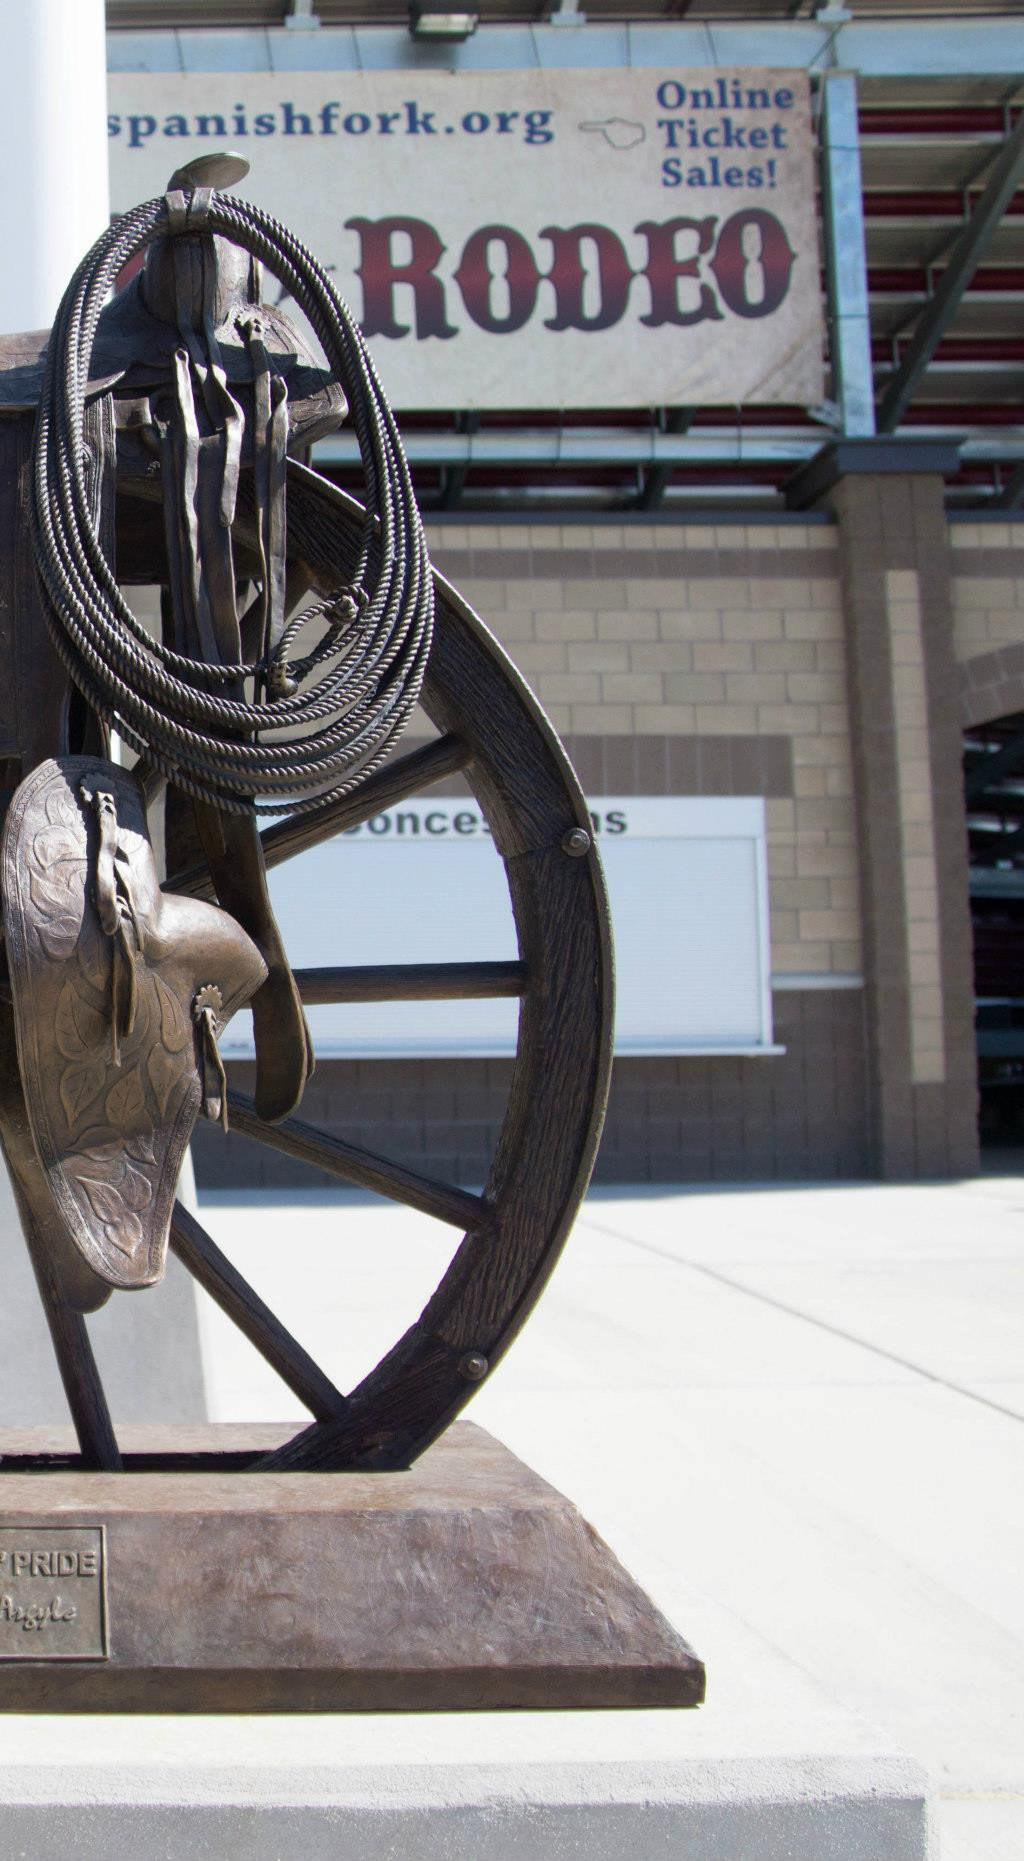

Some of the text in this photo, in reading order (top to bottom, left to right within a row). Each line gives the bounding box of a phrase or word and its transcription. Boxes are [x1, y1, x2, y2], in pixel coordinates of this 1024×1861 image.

[656, 78, 795, 110] Online
[657, 117, 787, 150] Ticket
[661, 156, 777, 189] Sales!
[344, 206, 796, 340] RODEO
[13, 1551, 98, 1577] PRIDE
